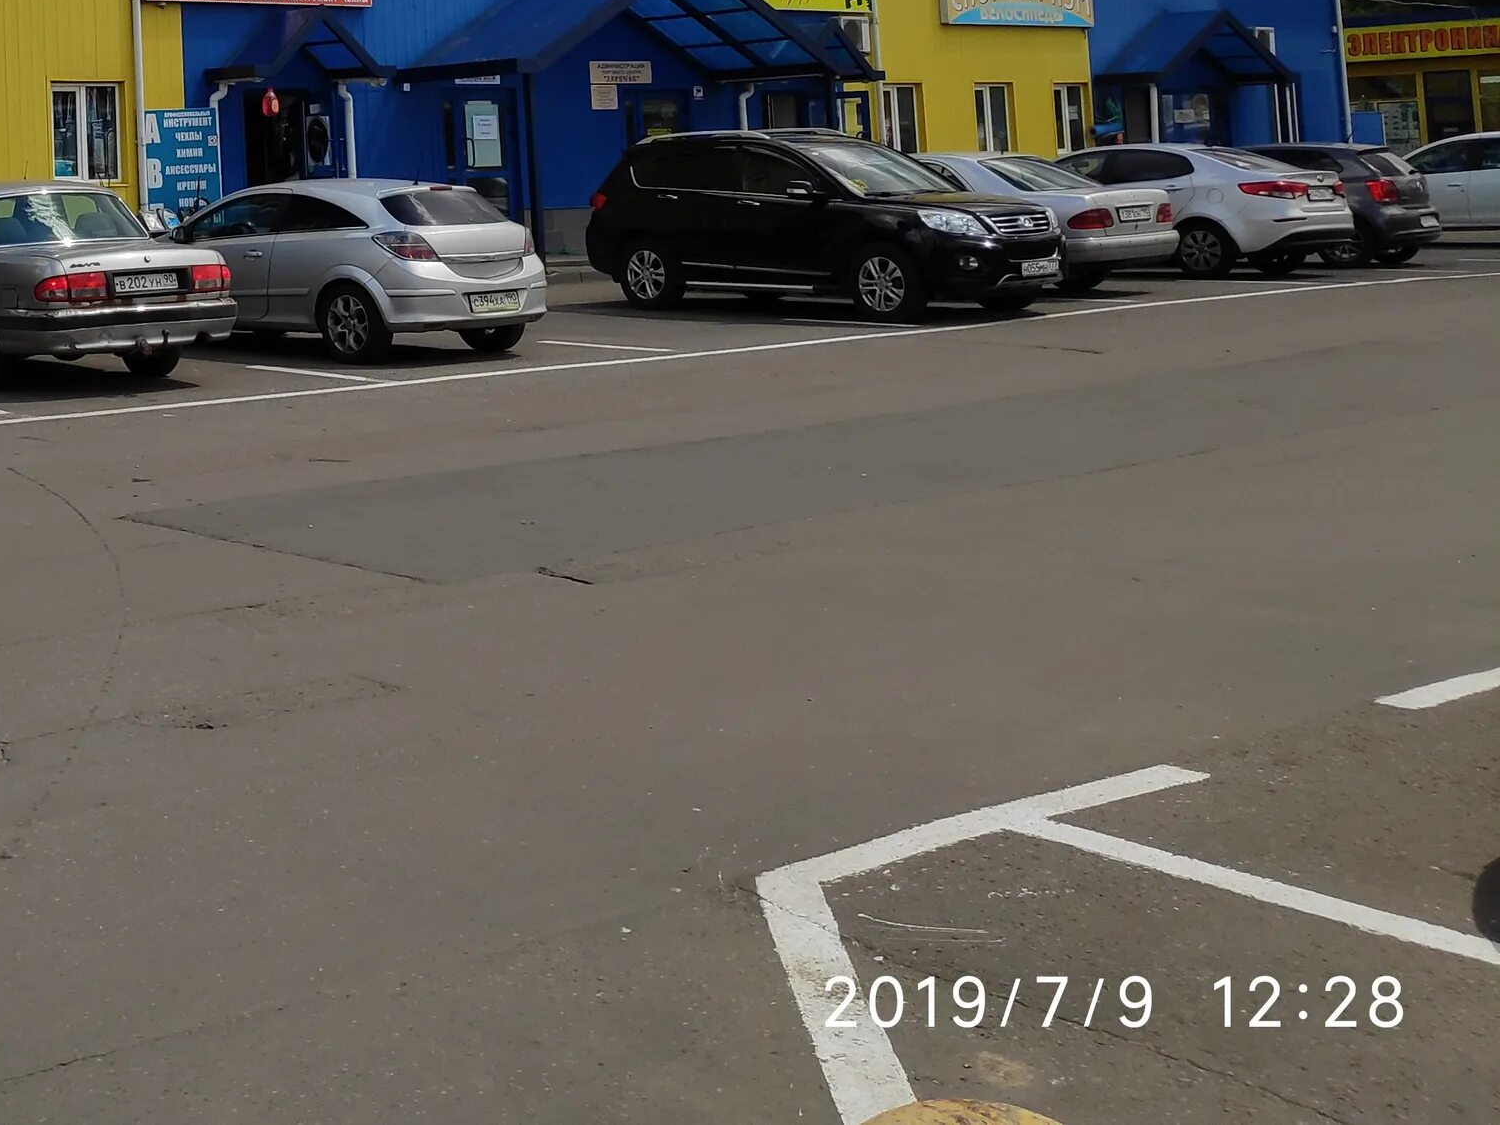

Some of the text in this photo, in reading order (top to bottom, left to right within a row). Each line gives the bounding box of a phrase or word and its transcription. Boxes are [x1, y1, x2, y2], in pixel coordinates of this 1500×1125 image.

[1347, 25, 1500, 57] ЭЛЕКТРОНИК
[163, 117, 213, 128] ИНСТРУМЕНТ
[175, 131, 203, 142] ЧЕХЛЫ
[176, 148, 203, 158] ХИМИЯ
[165, 163, 217, 175] АКСЕССУАРЫ
